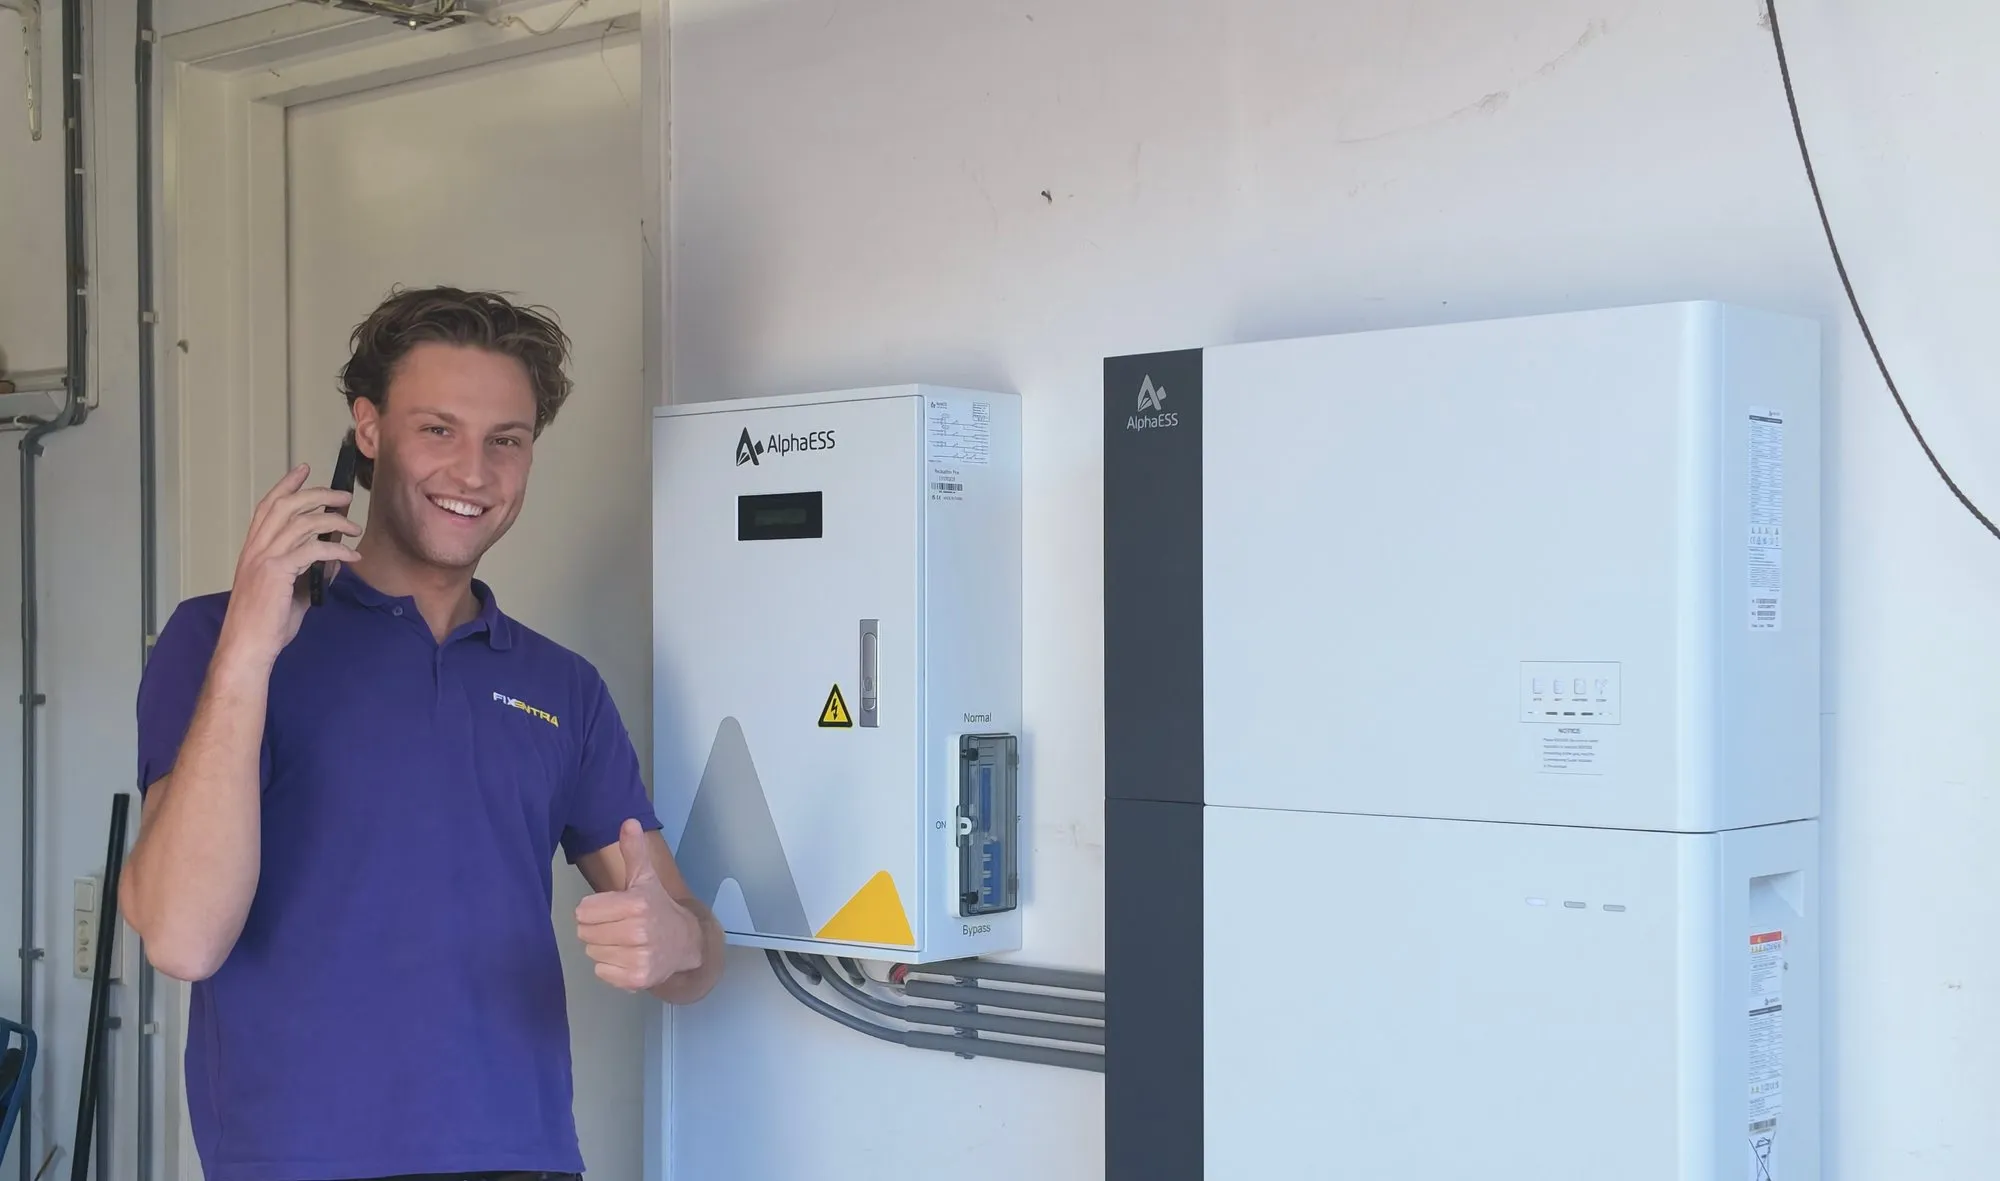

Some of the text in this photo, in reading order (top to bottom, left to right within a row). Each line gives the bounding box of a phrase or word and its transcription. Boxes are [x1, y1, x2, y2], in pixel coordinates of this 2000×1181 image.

[1126, 412, 1179, 432] AlphaESS
[767, 430, 836, 457] AlphaESS
[493, 691, 559, 728] FIXENTRA
[963, 712, 992, 723] Normal
[935, 820, 946, 830] ON
[962, 924, 991, 937] Bypass
